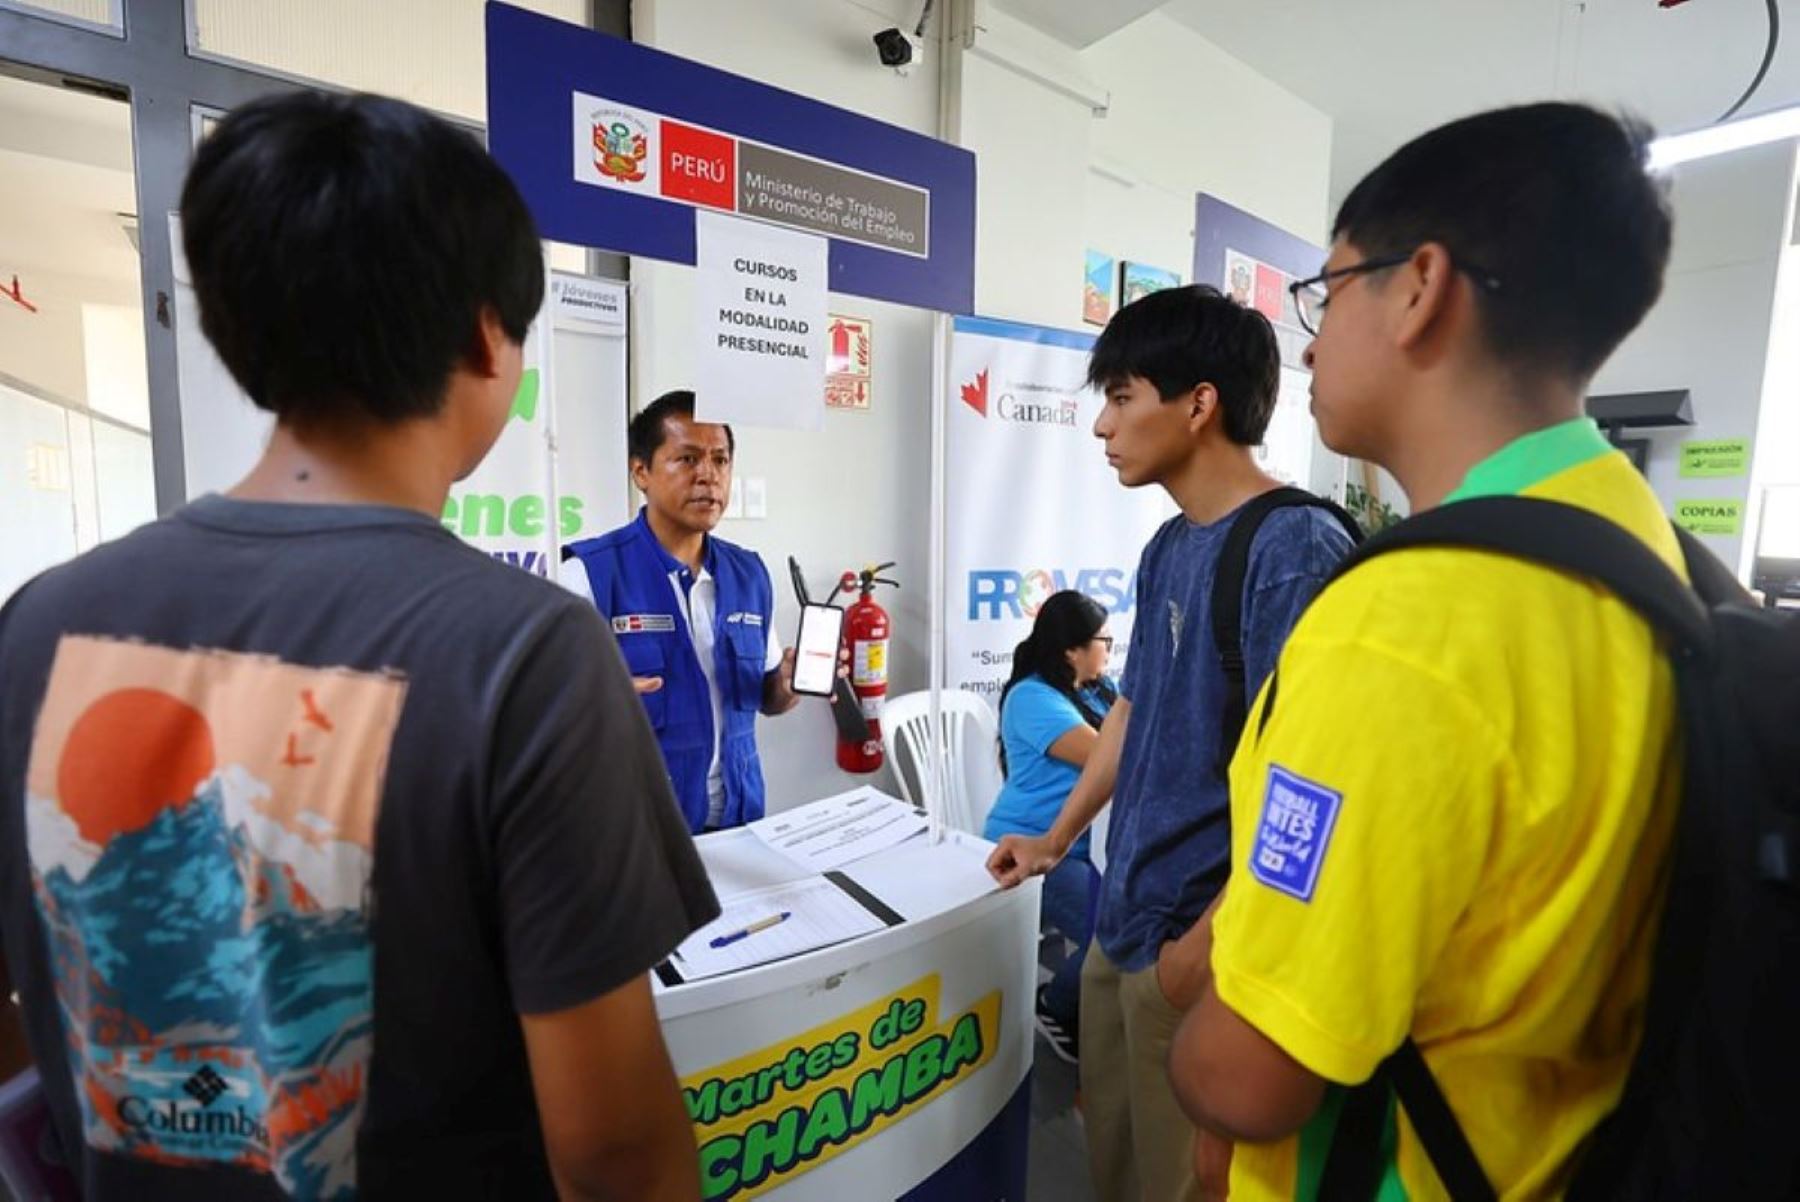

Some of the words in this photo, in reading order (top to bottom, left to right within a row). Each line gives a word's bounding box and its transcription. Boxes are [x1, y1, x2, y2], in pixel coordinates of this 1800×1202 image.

[671, 151, 726, 184] PERÚ
[745, 170, 823, 204] Ministerio
[825, 192, 844, 210] de
[847, 197, 897, 224] Trabajo
[759, 192, 839, 225] Promoción
[841, 214, 863, 232] del
[866, 218, 915, 244] Empleo
[733, 257, 798, 282] CURSOS
[744, 287, 766, 304] EN
[768, 291, 787, 306] LA
[719, 309, 809, 335] MODALIDAD
[717, 333, 809, 360] PRESENCIAL
[997, 394, 1077, 427] Canada
[1681, 506, 1738, 518] COPIAS
[683, 1030, 860, 1125] Martes
[869, 997, 927, 1051] de
[697, 1012, 984, 1201] CHAMBA
